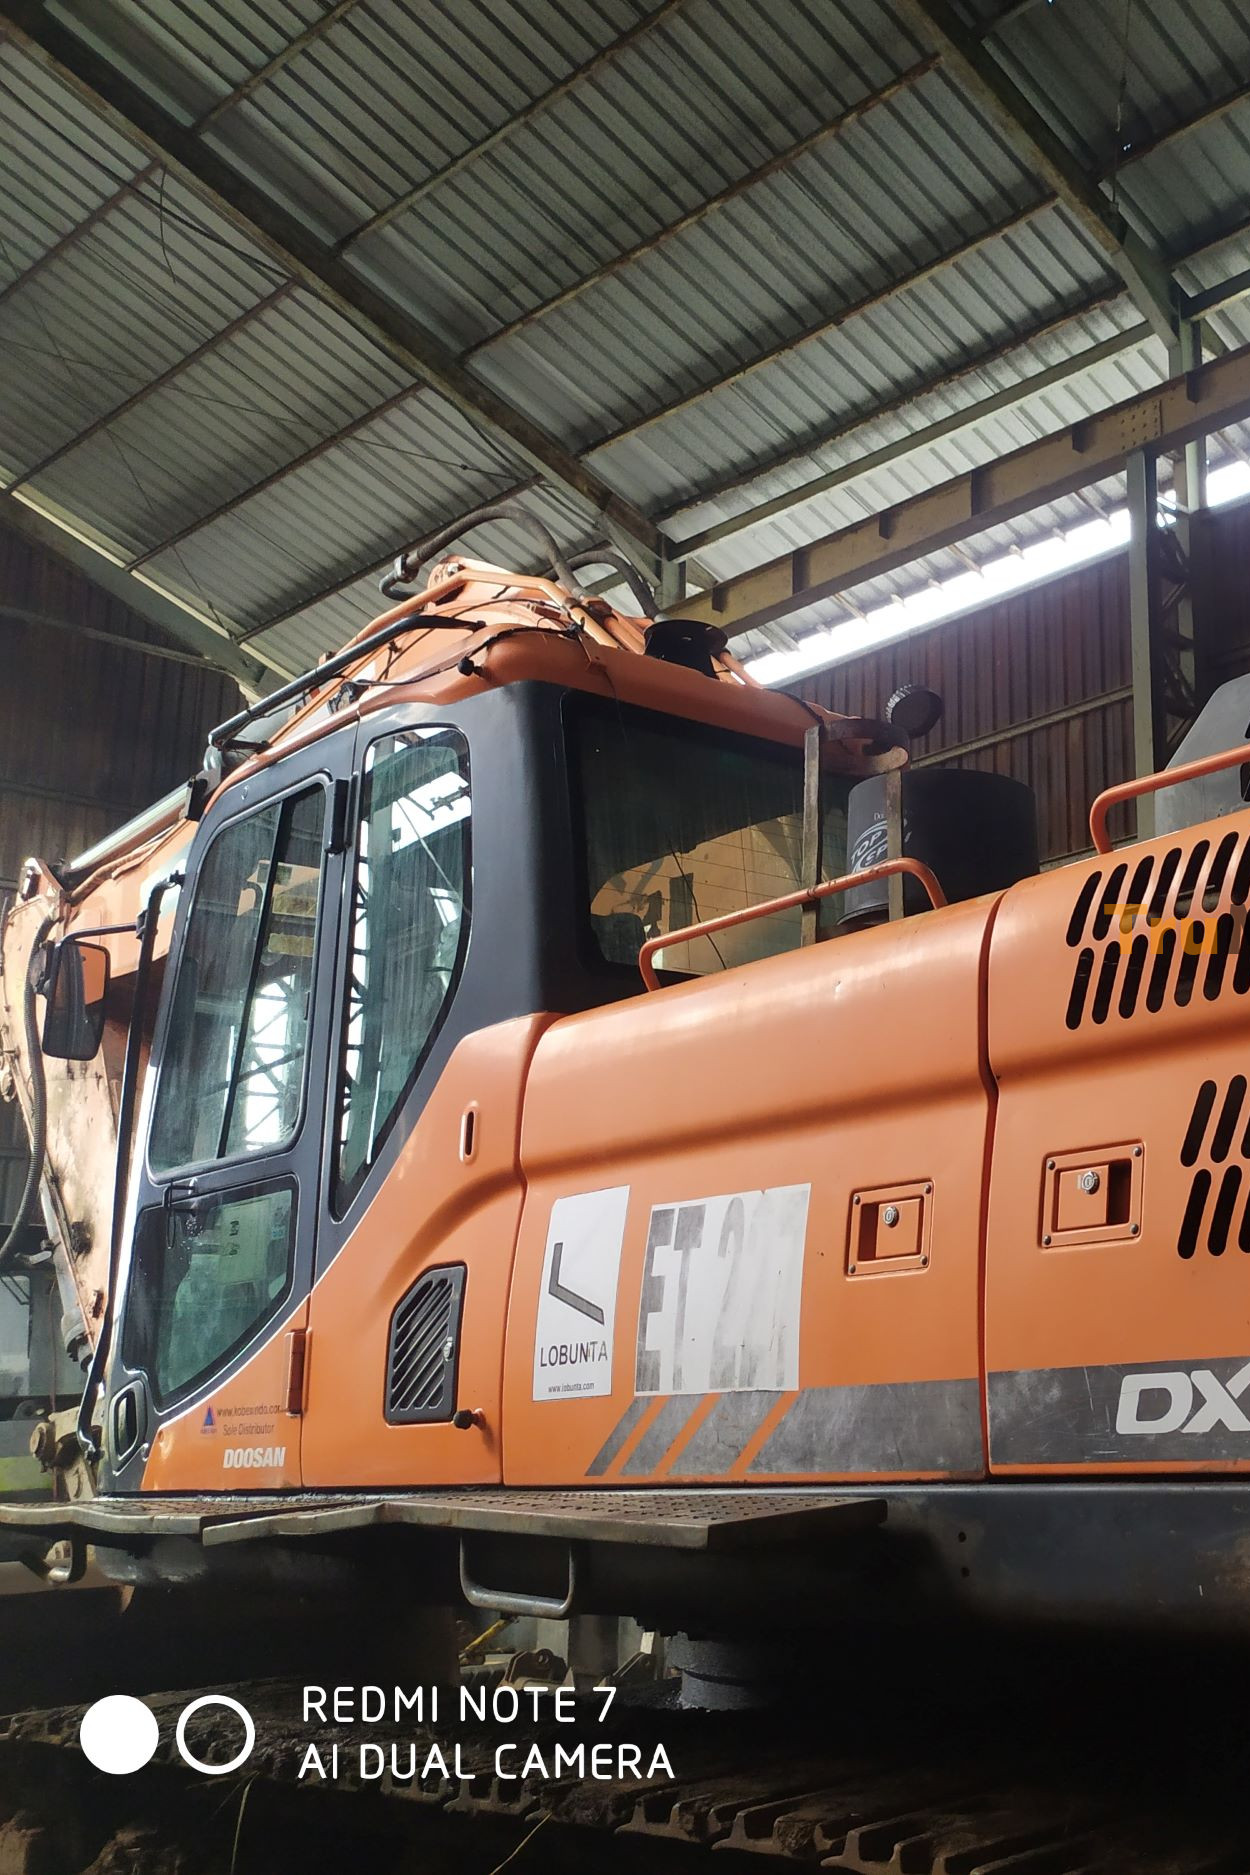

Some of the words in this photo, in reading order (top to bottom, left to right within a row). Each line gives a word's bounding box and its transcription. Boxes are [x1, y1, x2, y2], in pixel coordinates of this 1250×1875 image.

[851, 831, 882, 864] TOP
[540, 1340, 608, 1367] LOBUNTA
[223, 1447, 286, 1469] DOOSAN
